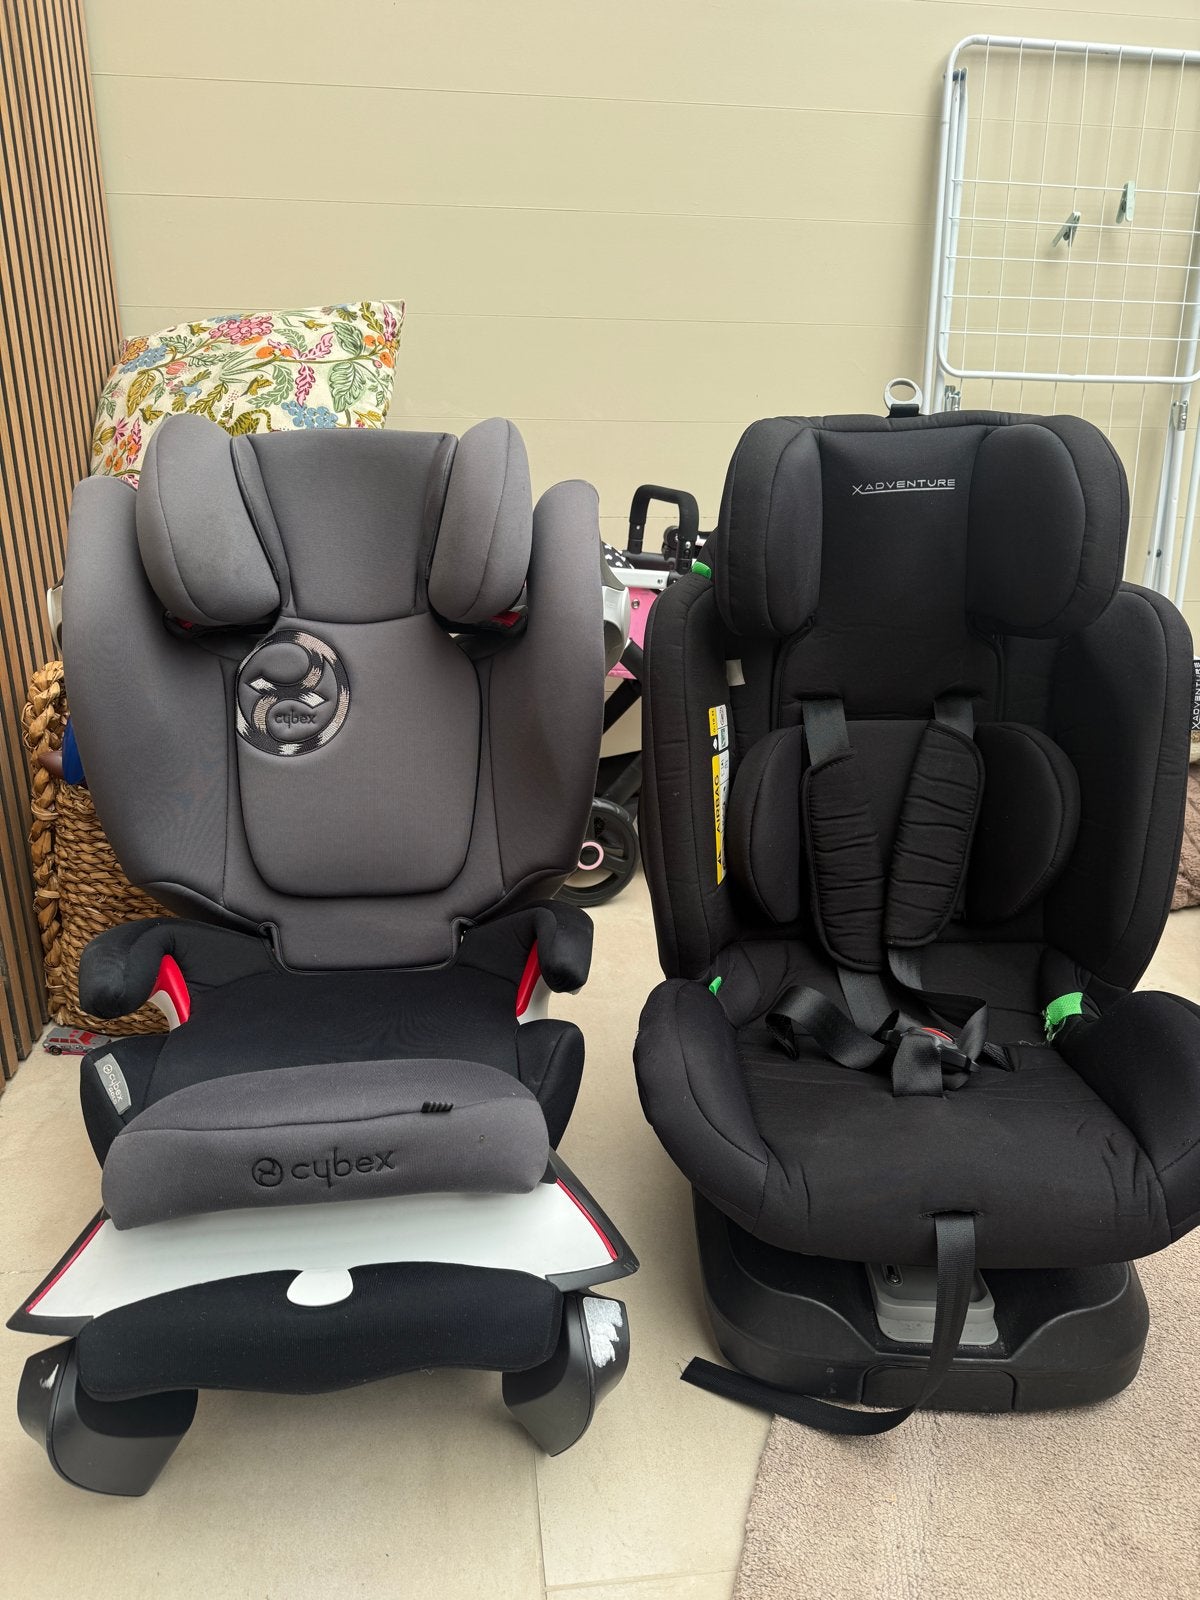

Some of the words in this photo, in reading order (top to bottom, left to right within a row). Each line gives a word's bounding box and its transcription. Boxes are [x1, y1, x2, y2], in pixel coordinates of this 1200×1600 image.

[274, 709, 315, 729] cybex
[109, 1073, 123, 1102] cybex
[291, 1147, 396, 1188] cybex
